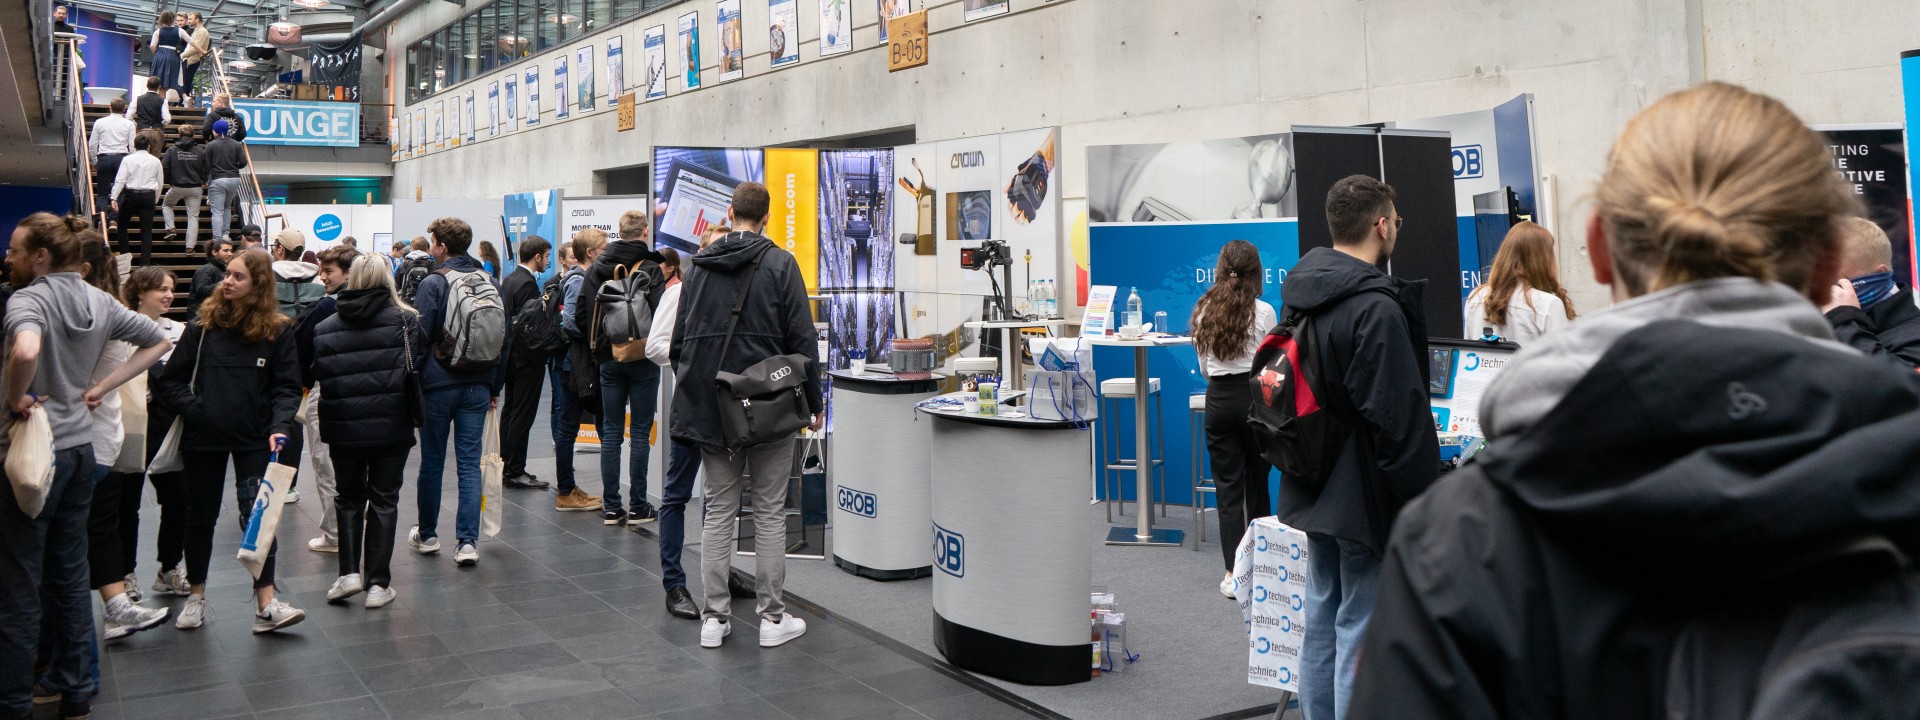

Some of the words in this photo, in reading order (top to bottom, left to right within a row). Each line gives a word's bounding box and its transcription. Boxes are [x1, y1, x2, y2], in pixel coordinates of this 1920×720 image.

[892, 38, 922, 65] B-05
[236, 108, 350, 137] OUNGE
[619, 110, 633, 128] B-06
[951, 151, 985, 169] CROWN
[1451, 148, 1481, 177] OB
[571, 209, 595, 217] CROWN
[838, 488, 875, 516] GROB
[1267, 541, 1290, 555] technica
[1268, 590, 1291, 605] technica
[1271, 642, 1298, 657] technica
